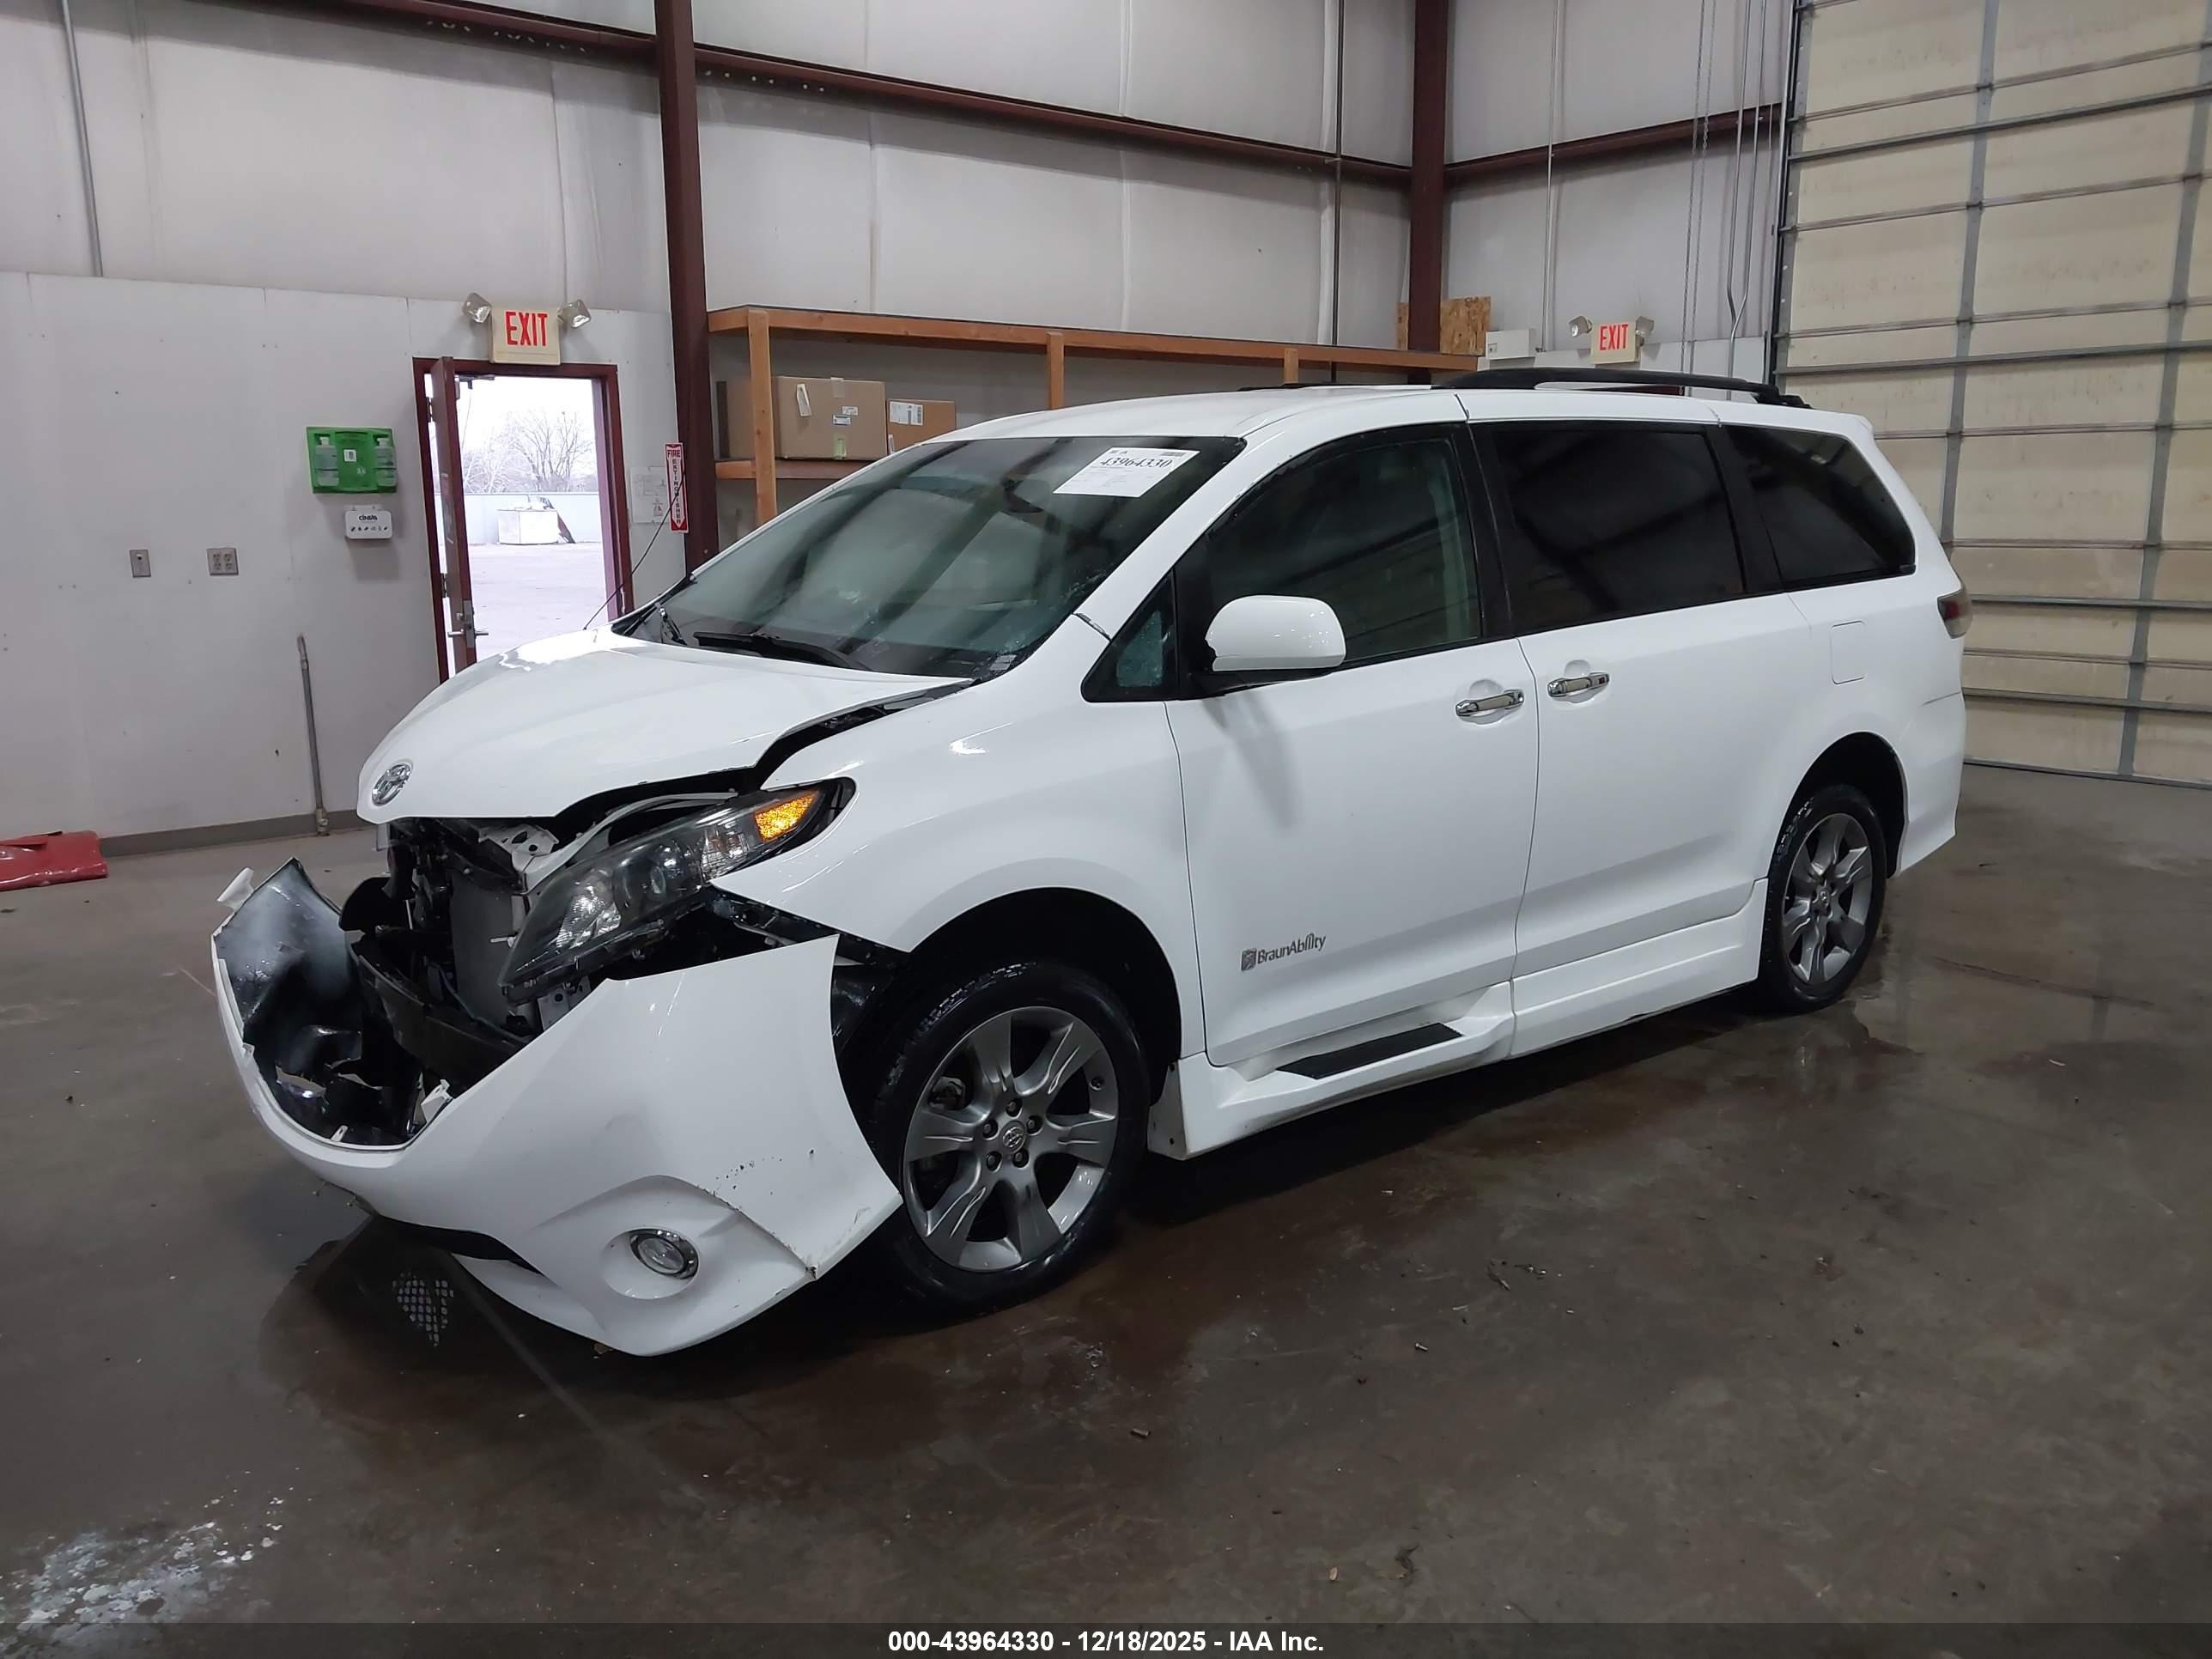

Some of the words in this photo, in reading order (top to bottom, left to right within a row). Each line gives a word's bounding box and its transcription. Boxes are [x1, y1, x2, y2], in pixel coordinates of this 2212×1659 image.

[505, 311, 548, 347] EXIT
[1599, 324, 1629, 351] EXIT
[667, 449, 681, 458] FIRE
[1100, 457, 1173, 467] 43964330
[1257, 933, 1326, 964] BraunAbility
